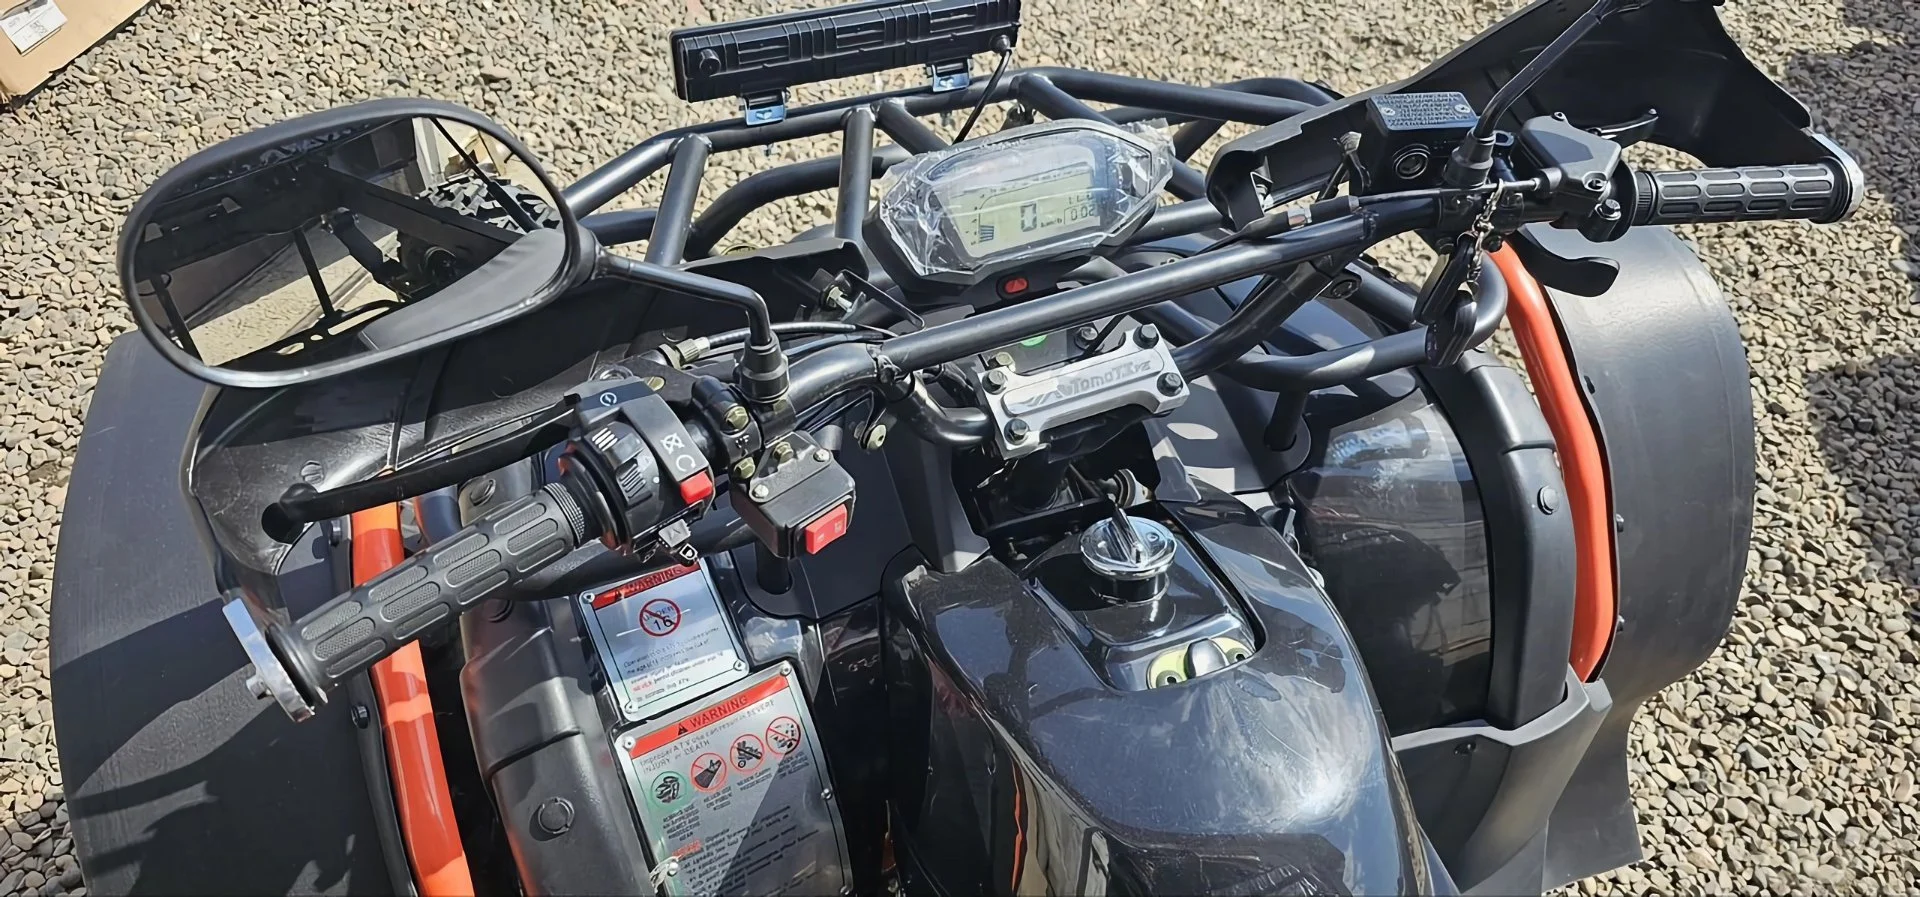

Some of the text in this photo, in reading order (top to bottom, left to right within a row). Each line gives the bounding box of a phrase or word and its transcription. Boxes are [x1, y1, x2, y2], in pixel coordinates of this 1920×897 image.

[624, 567, 682, 593] WARNING
[654, 615, 674, 632] 16
[689, 695, 748, 729] WARNING
[640, 748, 674, 767] Improper
[643, 757, 670, 775] INJURY
[683, 739, 710, 756] DEATH
